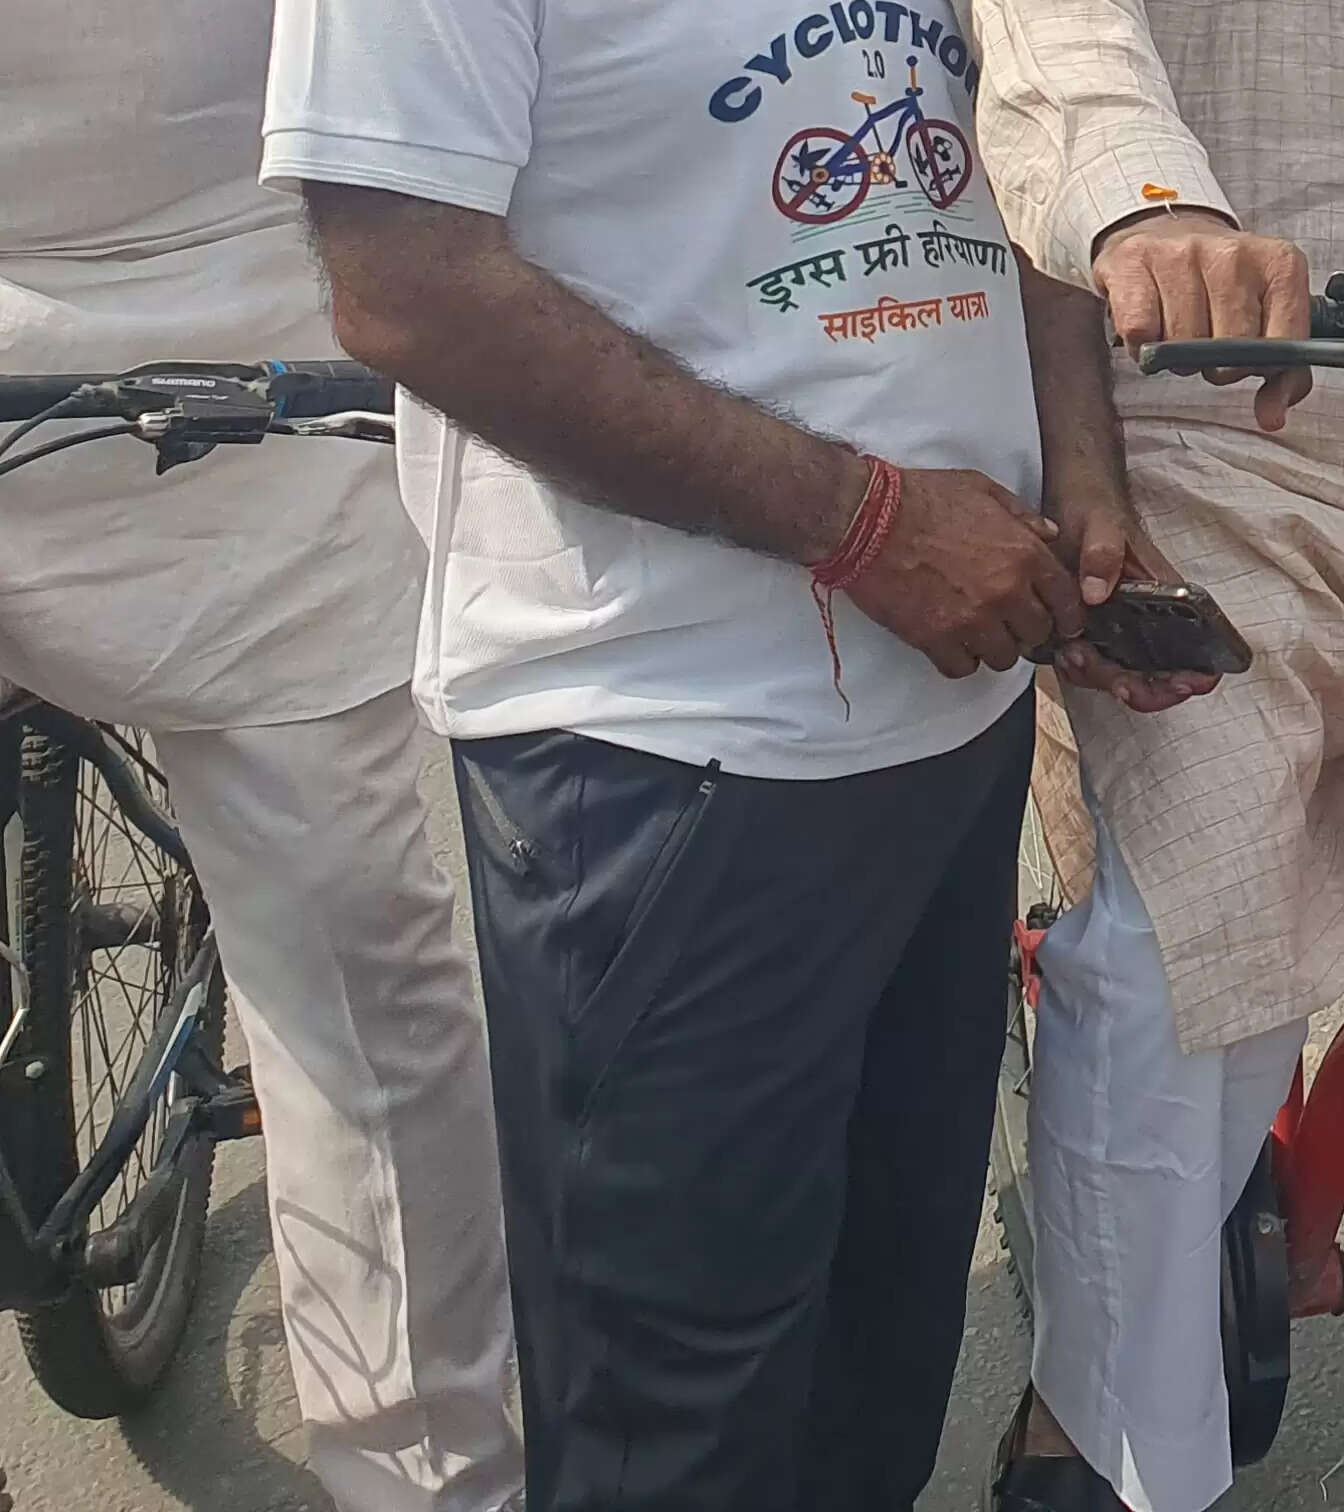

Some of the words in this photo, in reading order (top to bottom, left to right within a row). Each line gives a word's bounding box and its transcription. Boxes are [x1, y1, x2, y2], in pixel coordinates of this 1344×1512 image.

[861, 49, 886, 79] 2.0
[853, 223, 913, 276] फ्री
[916, 219, 1008, 276] हरियाणा
[816, 295, 943, 344] साइकिल
[946, 291, 990, 322] यात्रा
